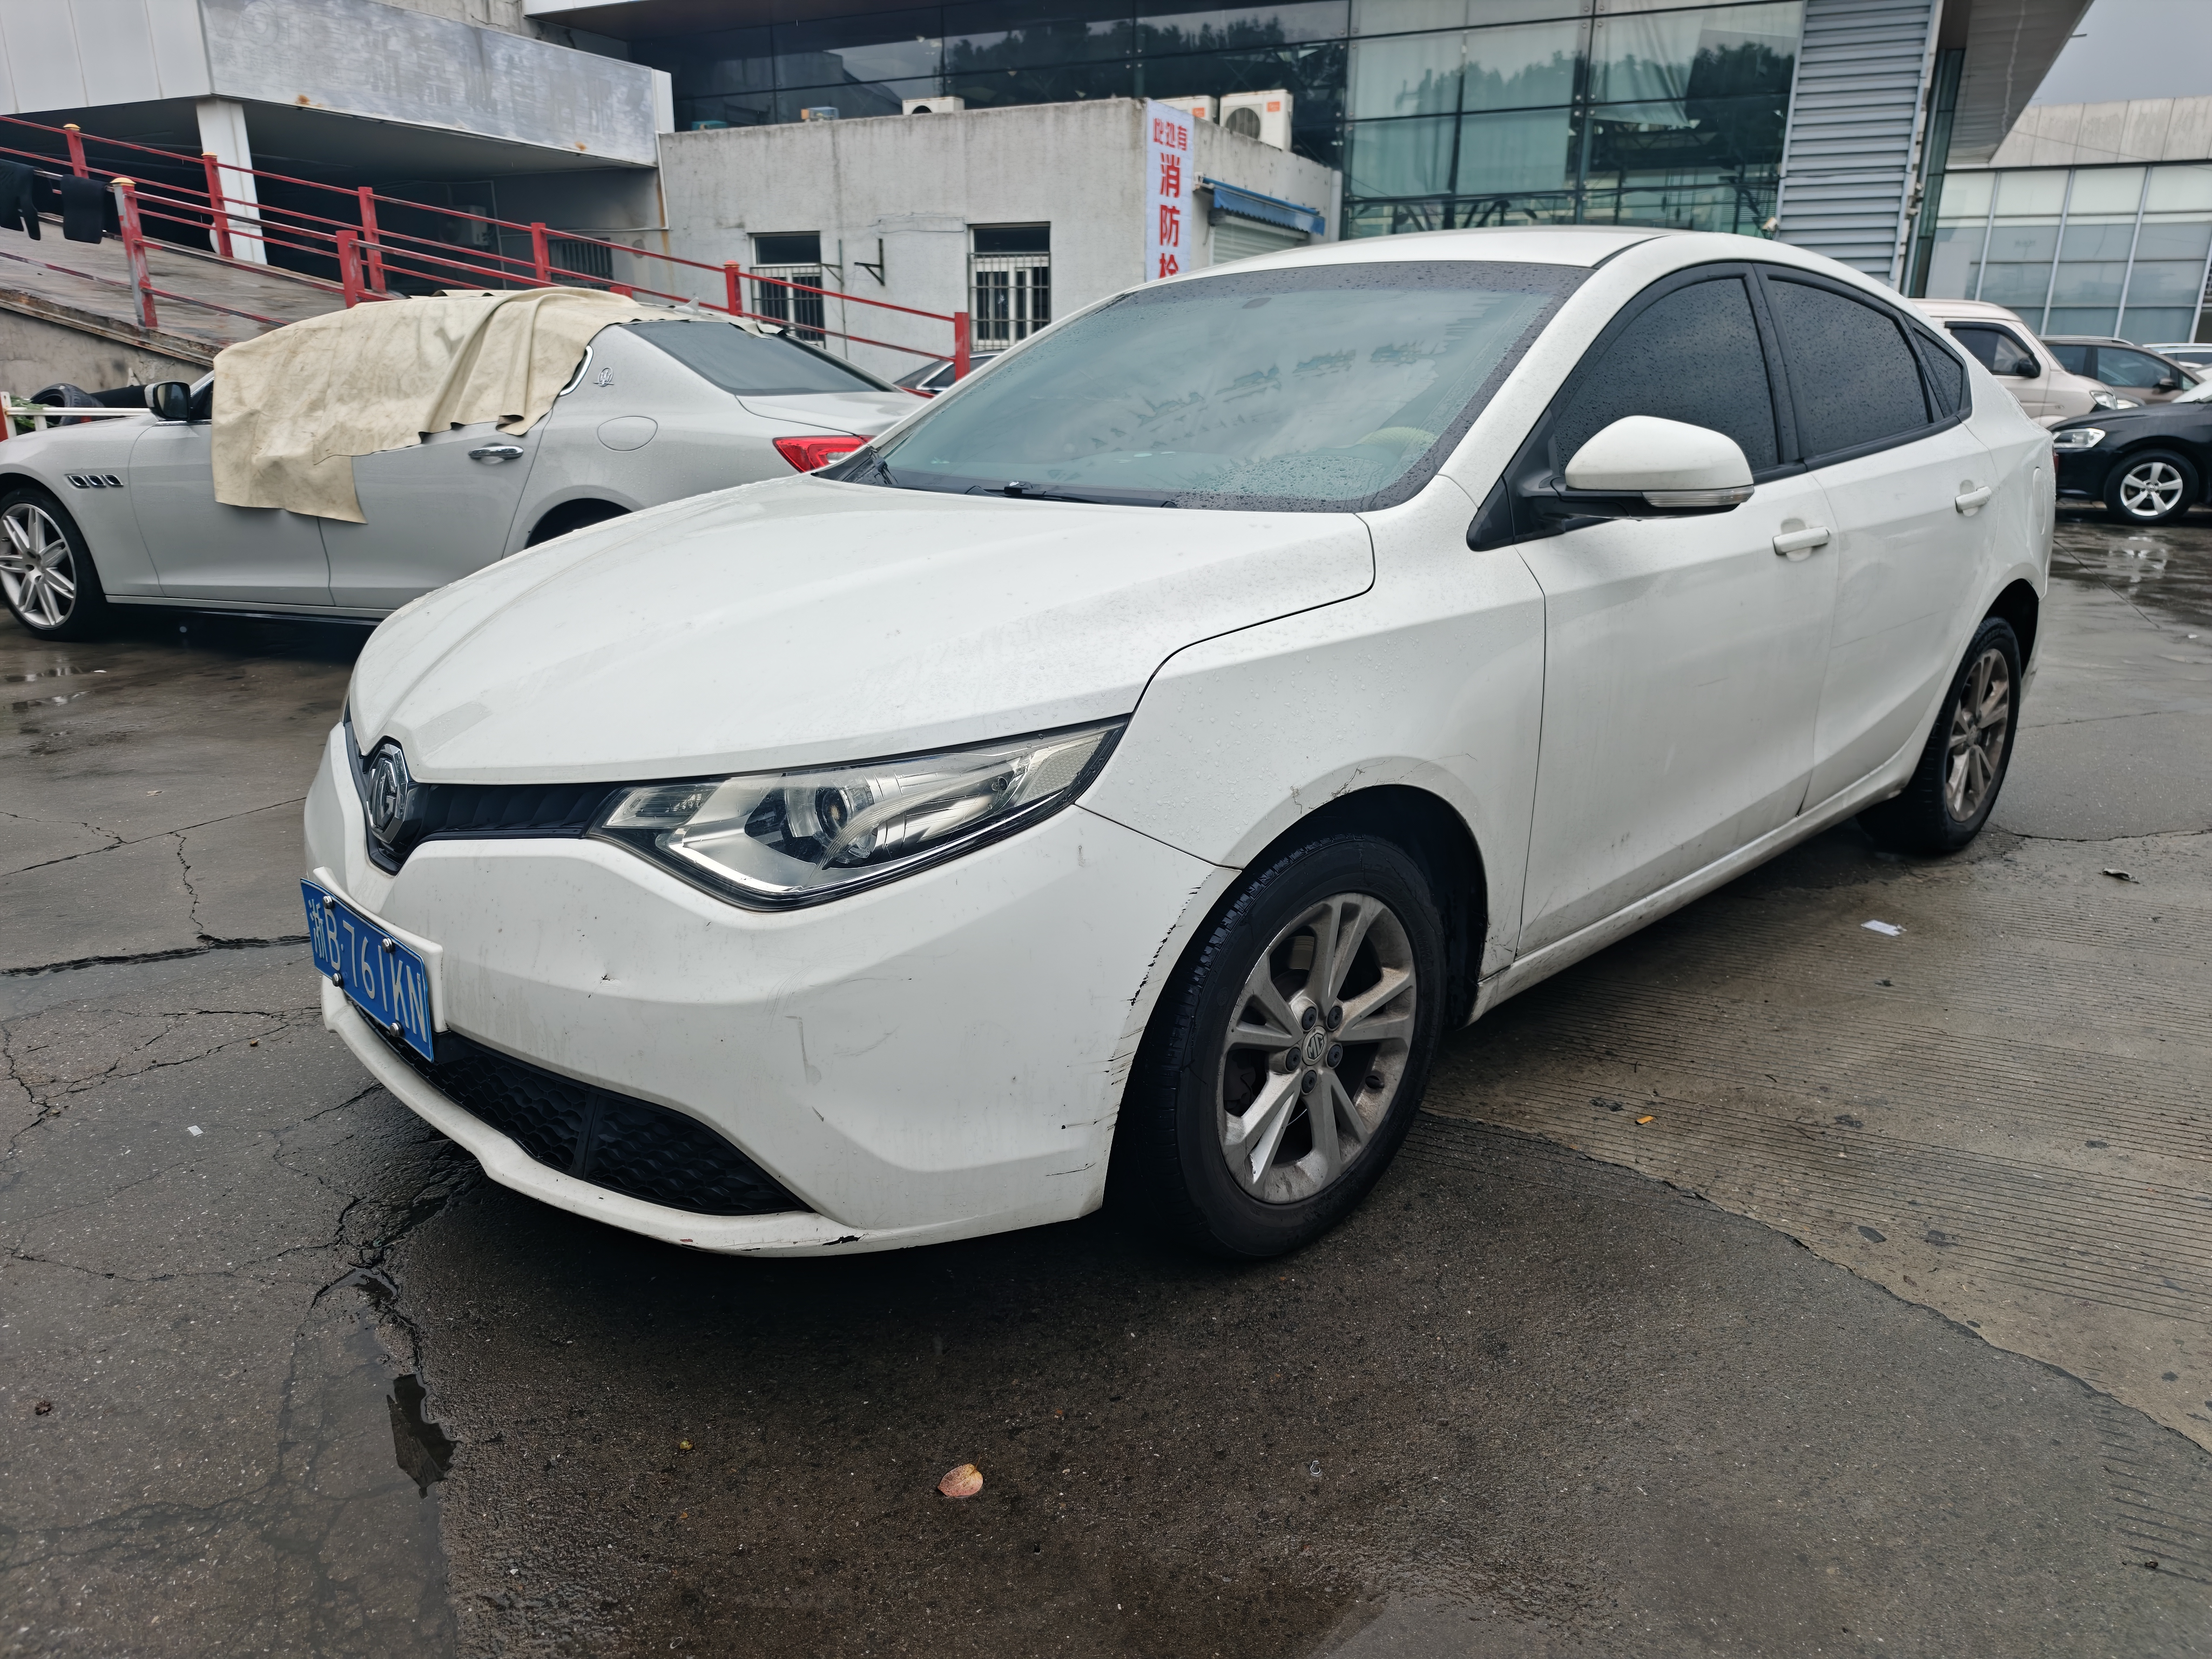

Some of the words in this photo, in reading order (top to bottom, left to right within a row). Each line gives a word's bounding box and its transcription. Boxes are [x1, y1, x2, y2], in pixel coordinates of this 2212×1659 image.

[1153, 118, 1187, 151] 此处有
[1307, 1033, 1324, 1059] MG
